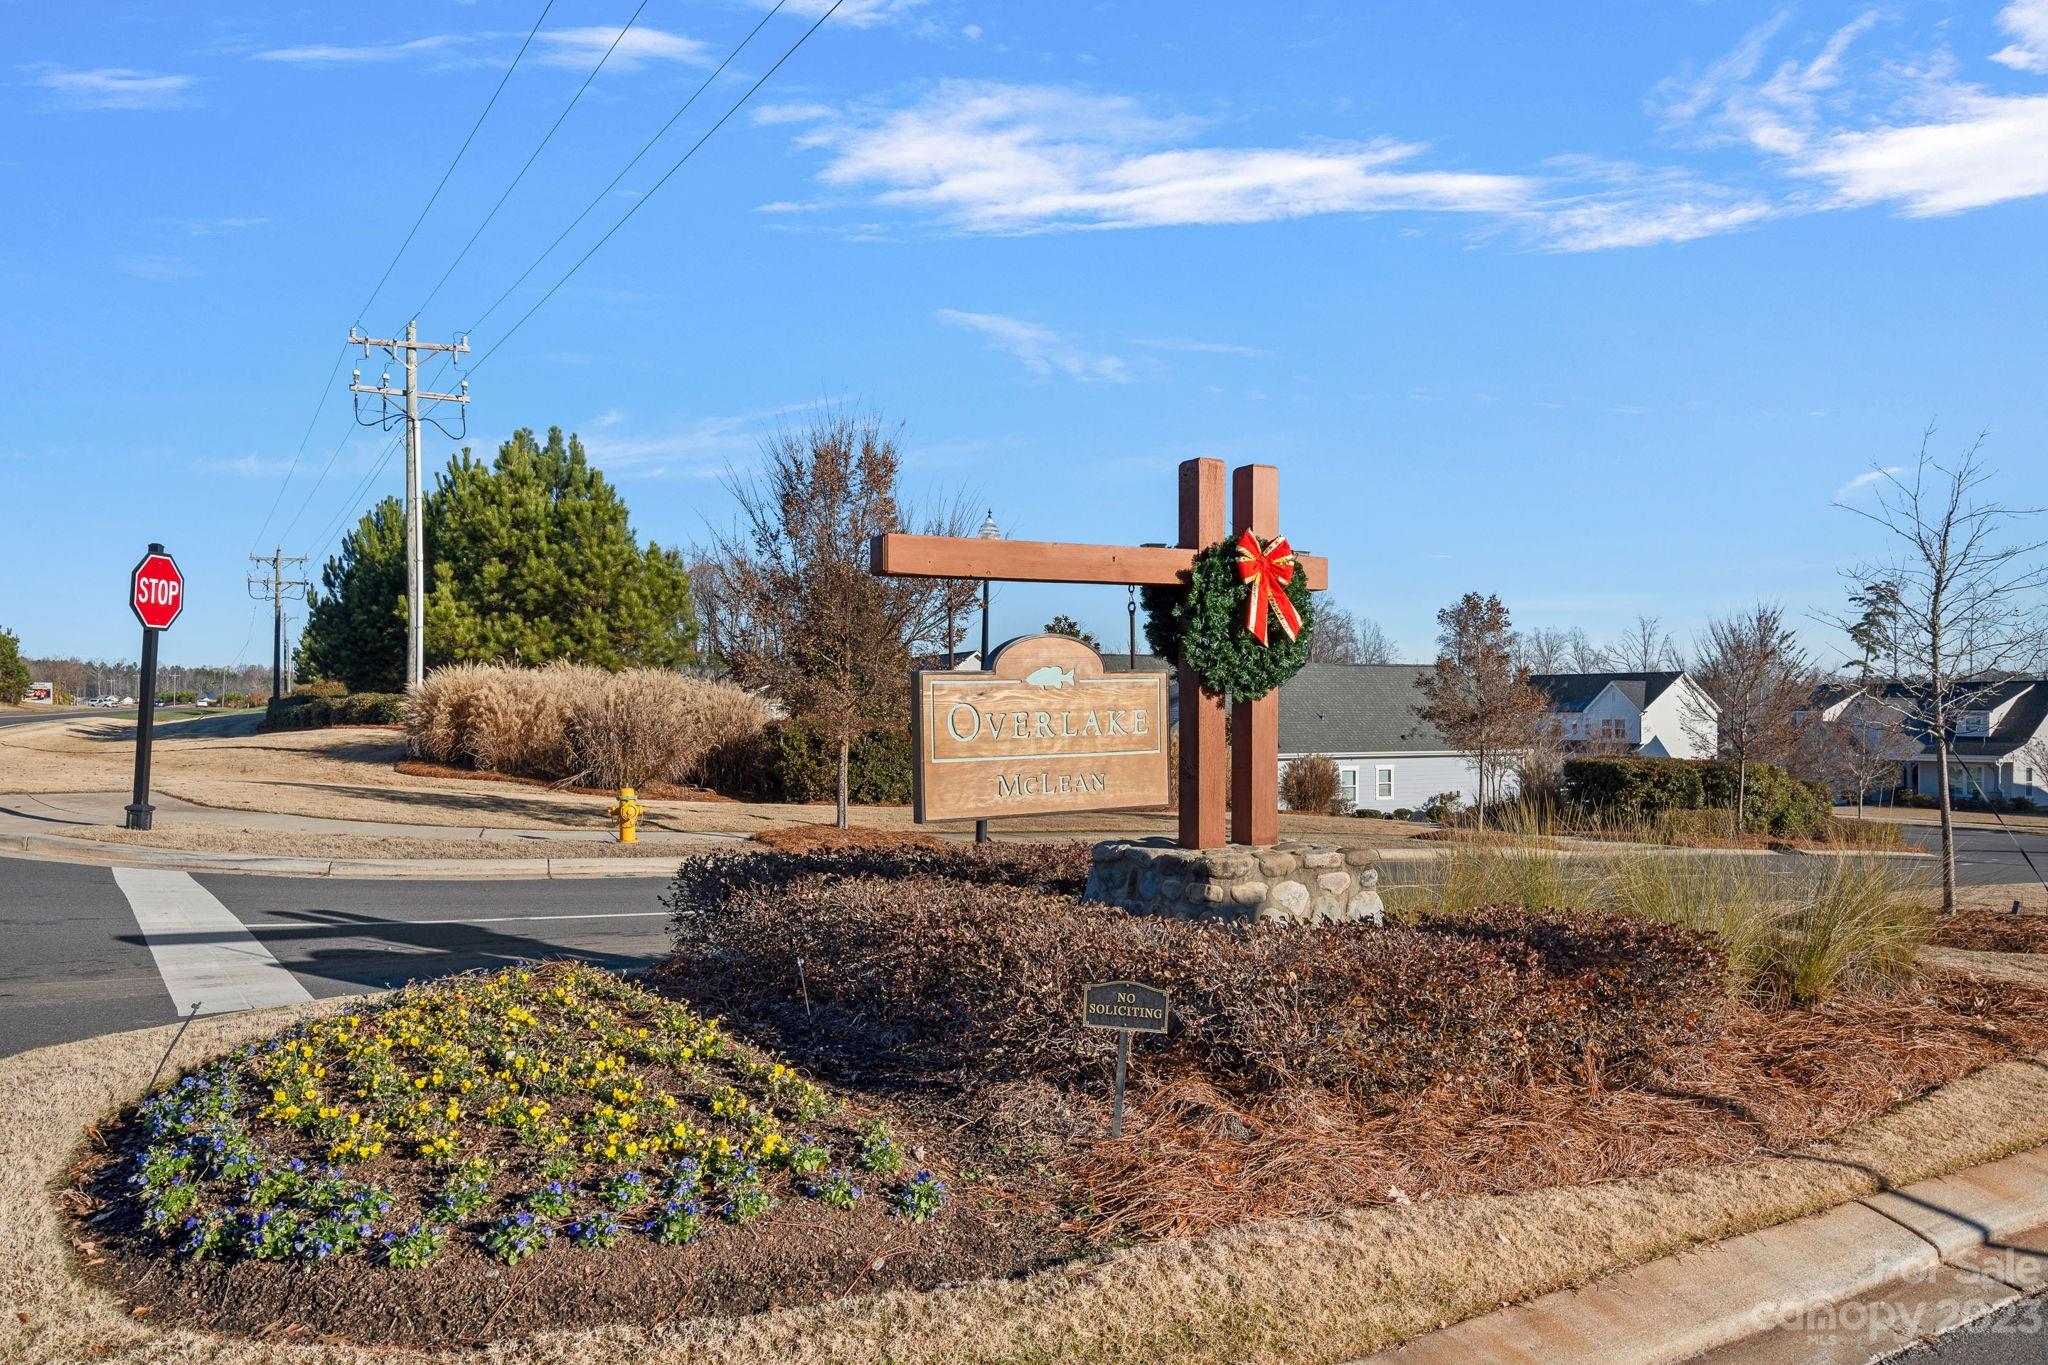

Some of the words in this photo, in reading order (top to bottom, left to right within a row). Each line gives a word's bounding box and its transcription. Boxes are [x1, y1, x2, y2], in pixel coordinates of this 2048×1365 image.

[138, 577, 179, 606] STOP
[947, 702, 1151, 742] OVERLAKE
[996, 772, 1106, 798] MCLEAN
[1117, 992, 1136, 1003] NO
[1089, 1003, 1162, 1019] SOLICITING
